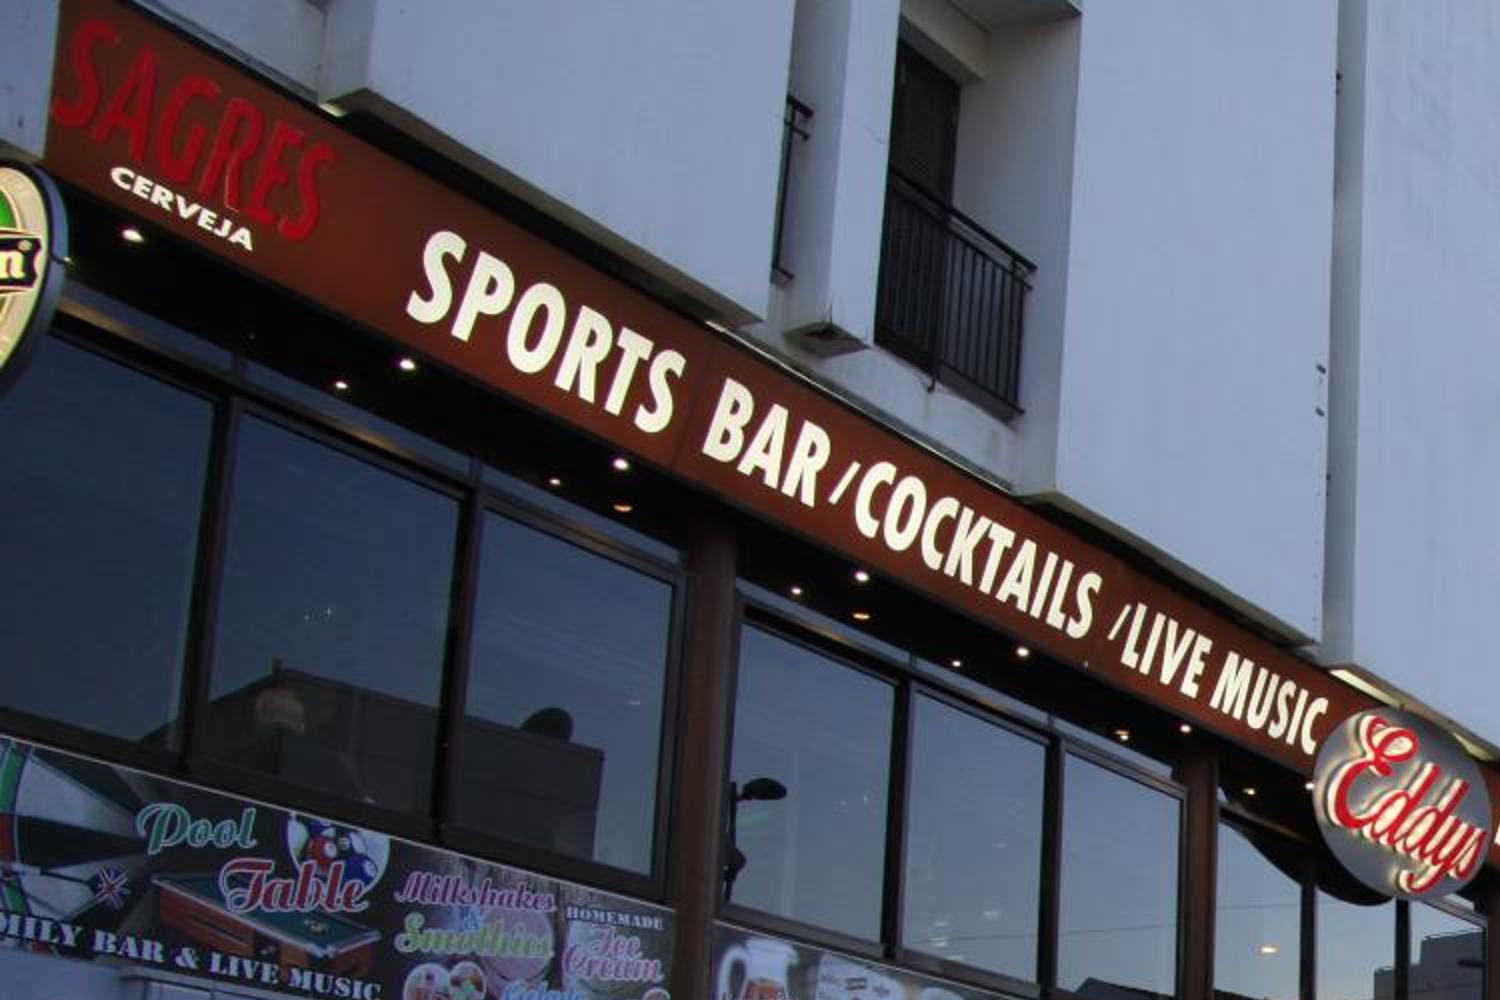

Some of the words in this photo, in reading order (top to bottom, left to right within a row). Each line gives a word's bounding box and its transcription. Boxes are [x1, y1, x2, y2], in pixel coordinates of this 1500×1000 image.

[51, 17, 339, 242] SAGRES
[110, 167, 253, 251] CERVEJA
[406, 230, 687, 433] SPORTS
[702, 377, 831, 508] BAR
[1209, 651, 1329, 755] MUSIC
[136, 802, 258, 856] Pool
[217, 857, 370, 914] Table
[566, 906, 664, 931] HOMEMADE
[590, 924, 642, 961] Ice
[94, 932, 164, 964] BAR
[175, 949, 200, 970] &
[209, 953, 279, 986] LIVE
[562, 945, 665, 983] Cream
